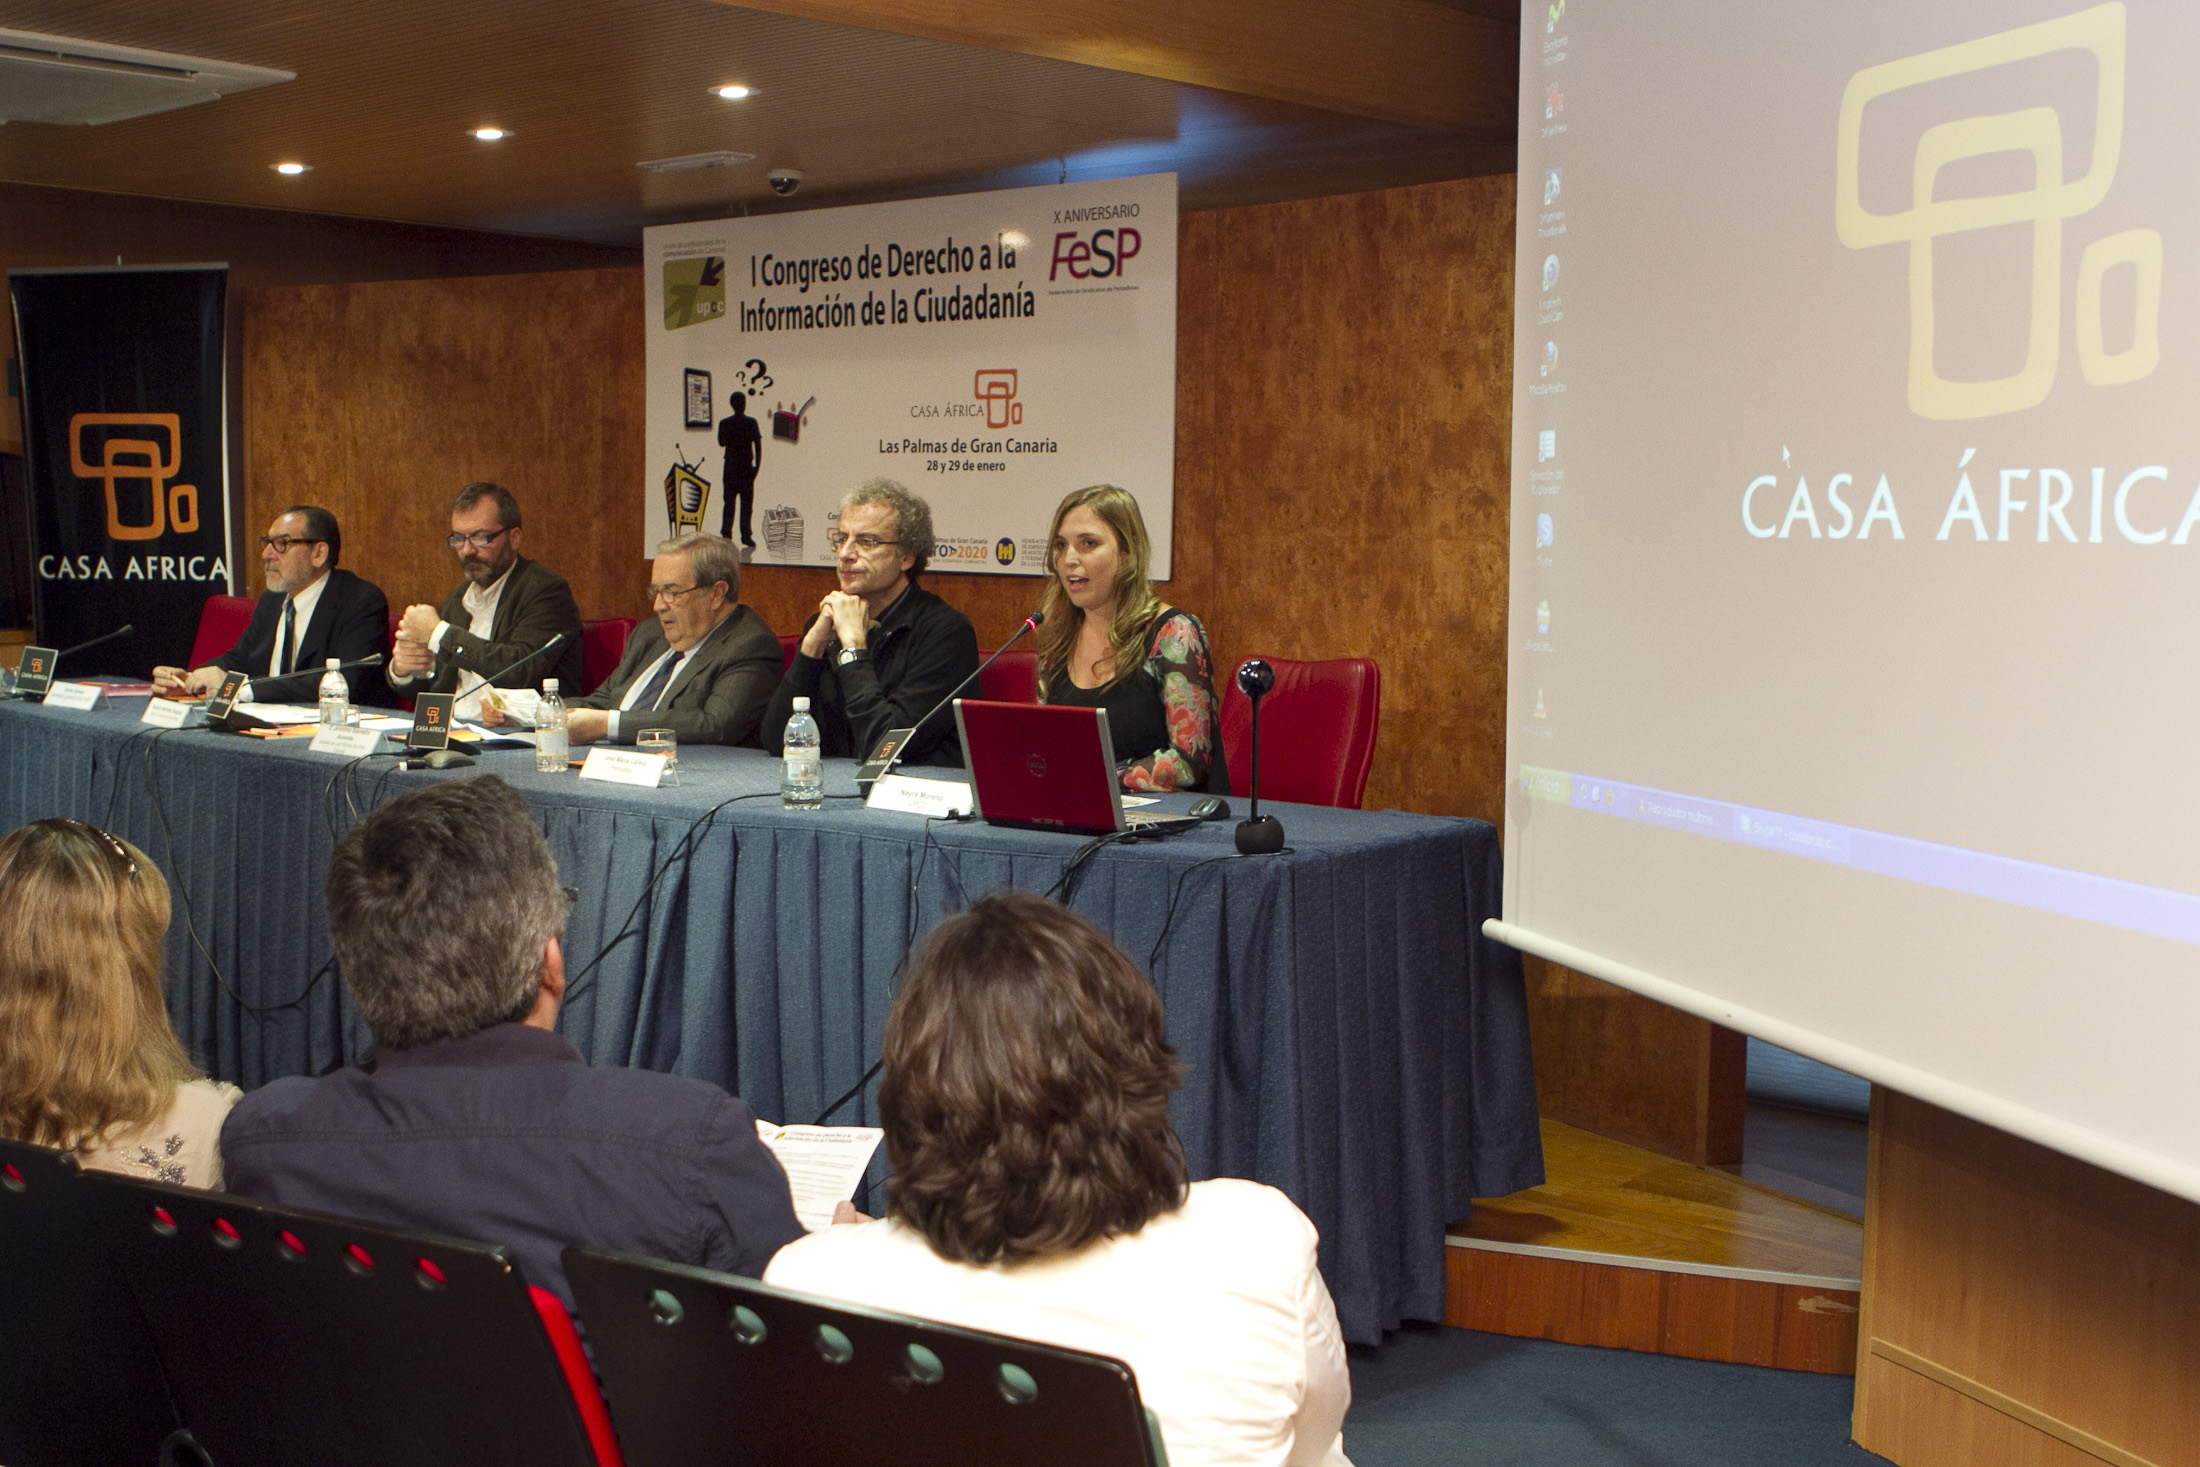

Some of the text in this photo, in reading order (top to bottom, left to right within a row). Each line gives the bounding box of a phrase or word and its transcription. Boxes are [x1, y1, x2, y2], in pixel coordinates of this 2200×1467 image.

[1053, 203, 1140, 224] X ANIVERSARIO
[752, 232, 1016, 293] I Congreso de Derecho a la
[1049, 227, 1142, 282] FeSP
[741, 280, 1035, 332] Información de la Ciudadanía
[910, 402, 984, 418] CASA ÁFRICA
[879, 437, 1057, 454] Las Palmas de Gran Canaria
[926, 459, 1006, 474] 28 y 29 de enero
[1741, 472, 1905, 540] CASA
[39, 555, 228, 581] CASA AFRICA
[415, 724, 428, 732] CASA
[900, 788, 944, 802] Nayra Moreno
